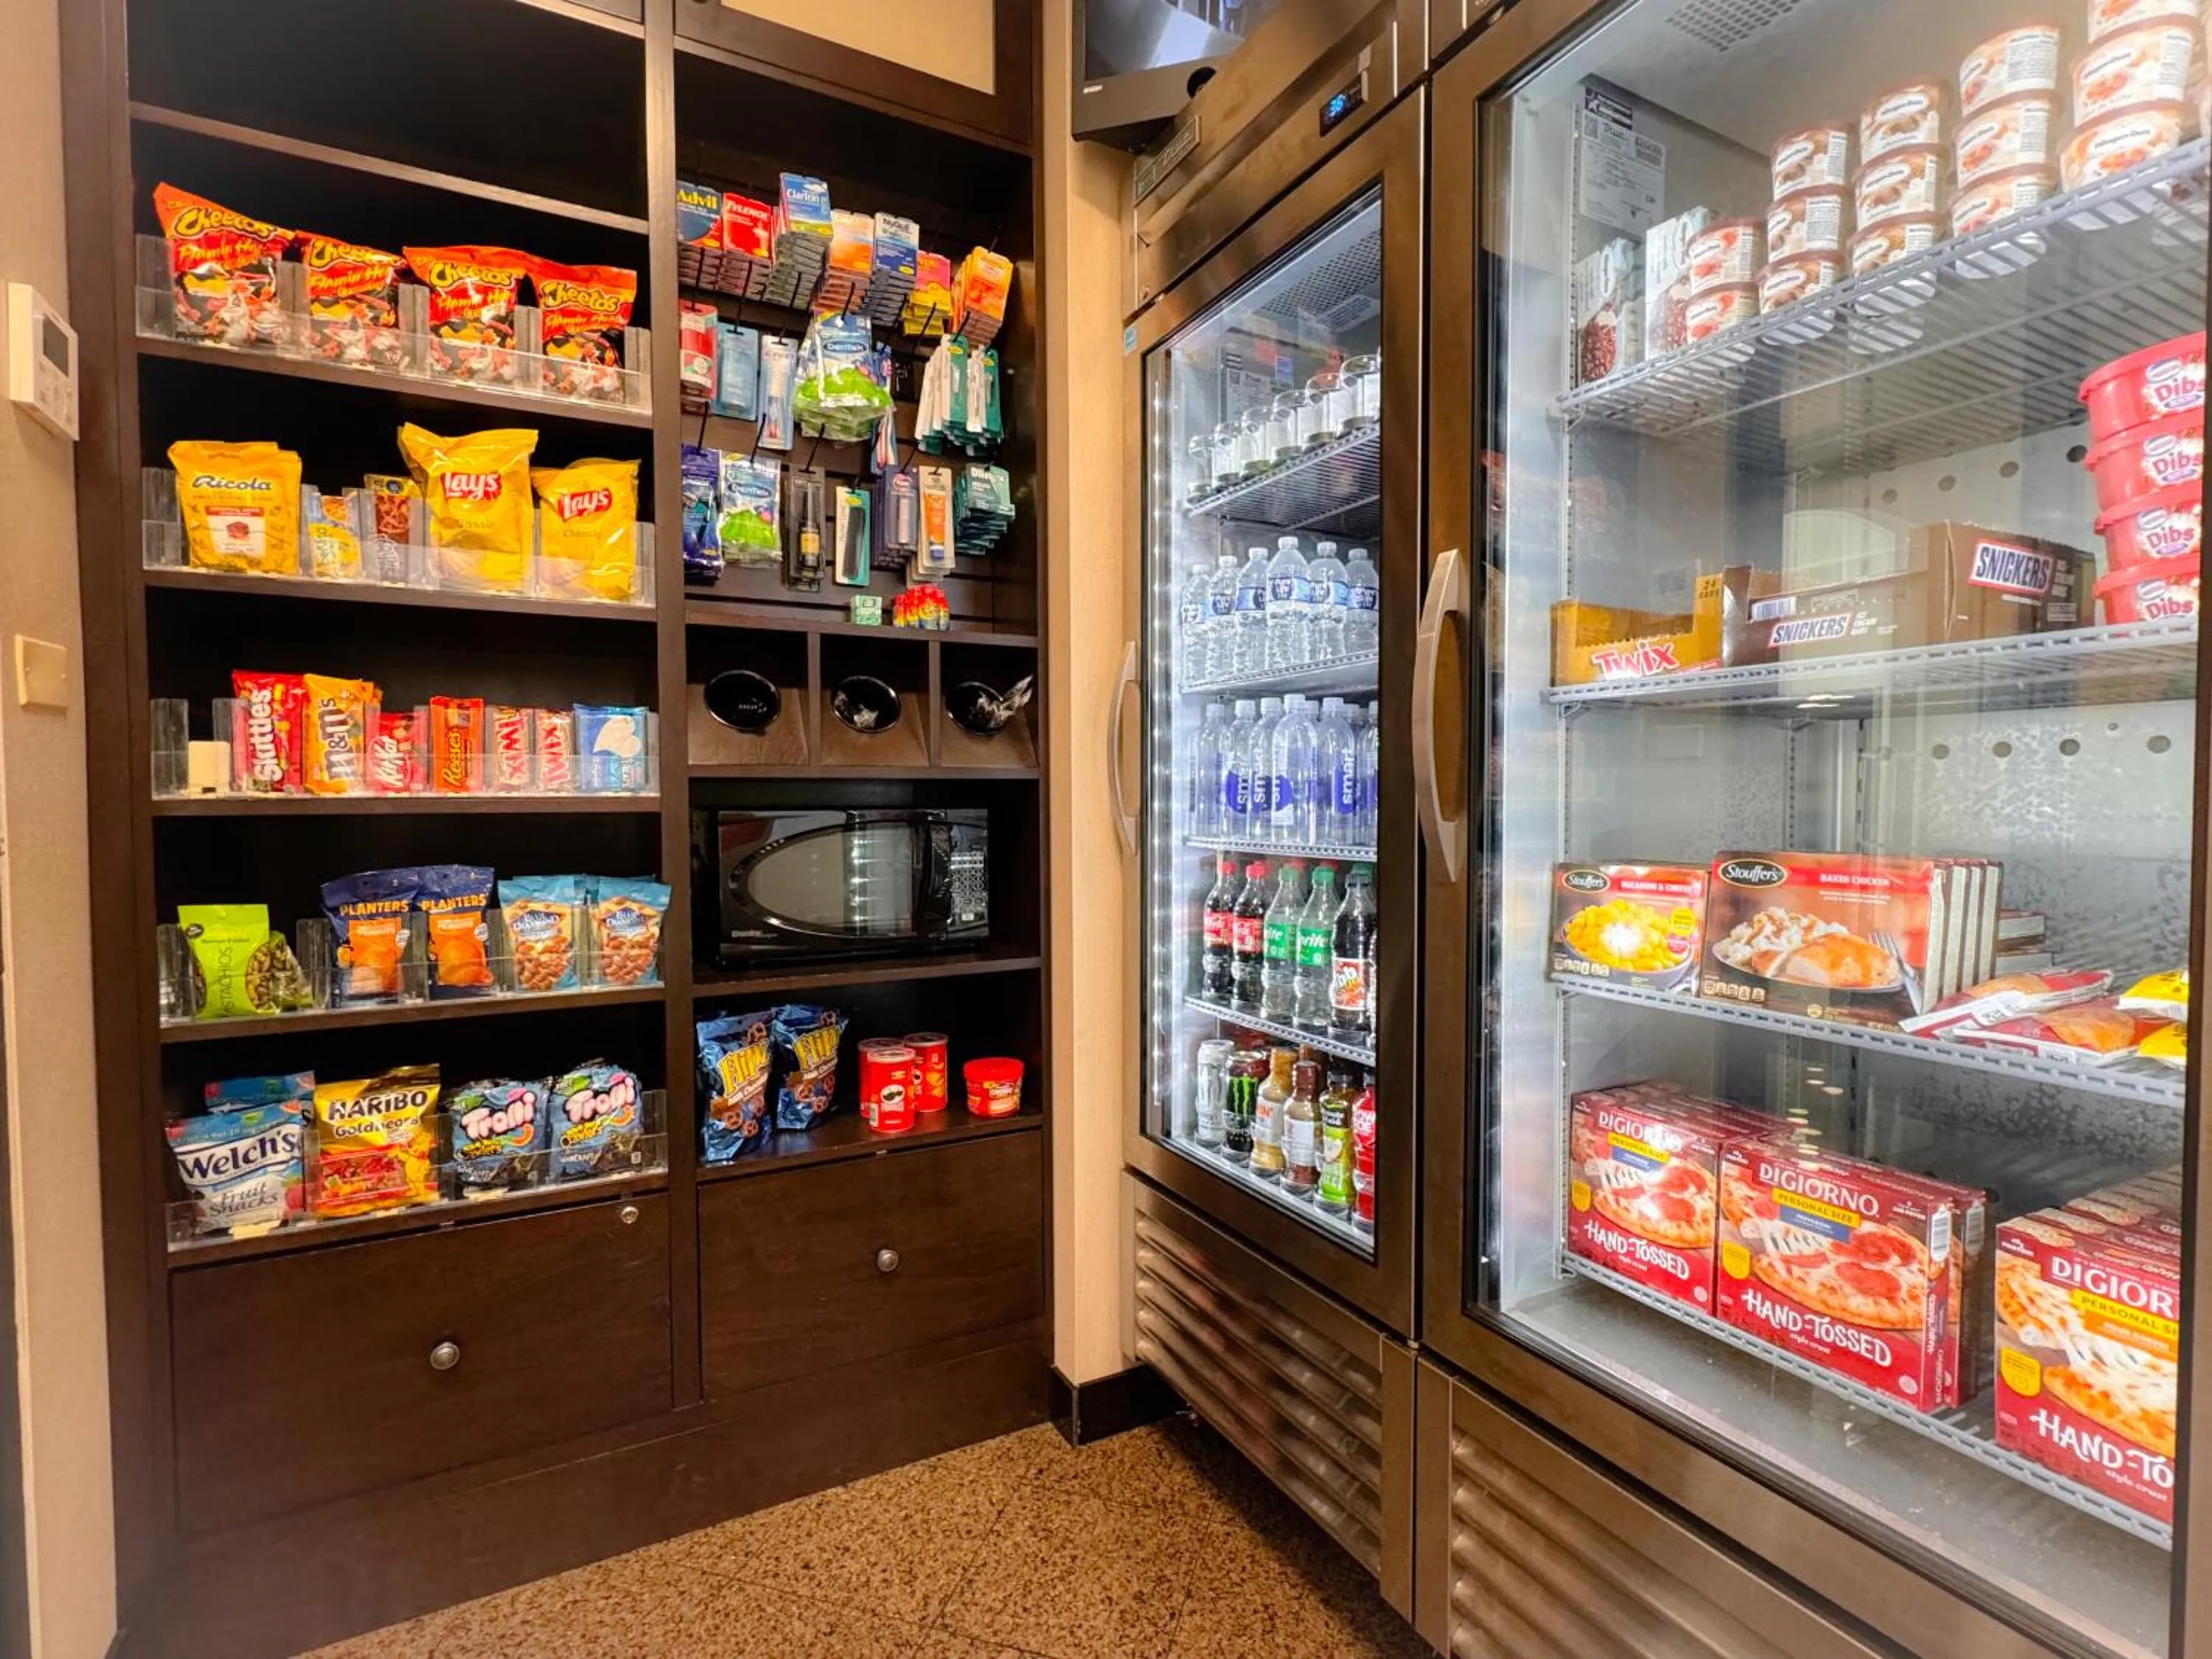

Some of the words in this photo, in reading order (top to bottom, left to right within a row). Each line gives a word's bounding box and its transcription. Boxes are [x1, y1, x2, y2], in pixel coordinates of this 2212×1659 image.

[676, 188, 718, 209] Advil
[726, 201, 768, 220] TYLENOL
[175, 206, 276, 241] Cheetos
[429, 262, 513, 288] Cheetos
[543, 282, 619, 313] Cheetos
[2155, 376, 2205, 402] Dibs
[2152, 451, 2201, 476] Dibs
[192, 473, 272, 491] Ricola
[2146, 525, 2195, 549] Dibs
[1975, 546, 2050, 589] SNICKERS
[2146, 596, 2194, 619] Dibs
[1773, 616, 1847, 643] SNICKERS
[248, 689, 285, 783] Skittles
[442, 731, 463, 788] Reese's
[1342, 747, 1357, 805] smart
[1725, 863, 1781, 883] Stouffer's
[339, 900, 410, 917] PLANTERS
[421, 894, 487, 911] PLANTERS
[327, 1091, 429, 1121] HARIBO
[461, 1091, 535, 1141] Trolli
[566, 1077, 636, 1124] Trolli
[1598, 1110, 1683, 1152] DIGIOO
[178, 1130, 296, 1180] Welch's
[209, 1192, 279, 1217] Snacks
[222, 1182, 268, 1203] Fruit
[1759, 1162, 1879, 1217] DIGIORNO
[1778, 1193, 1829, 1217] PERSONAL
[1831, 1208, 1854, 1224] SIZE
[1583, 1219, 1690, 1281] HAND-TOSSED
[2051, 1256, 2179, 1319] DIGIOR
[1741, 1288, 1893, 1368] HAND-TOSSED
[2081, 1295, 2159, 1331] PERSONAL
